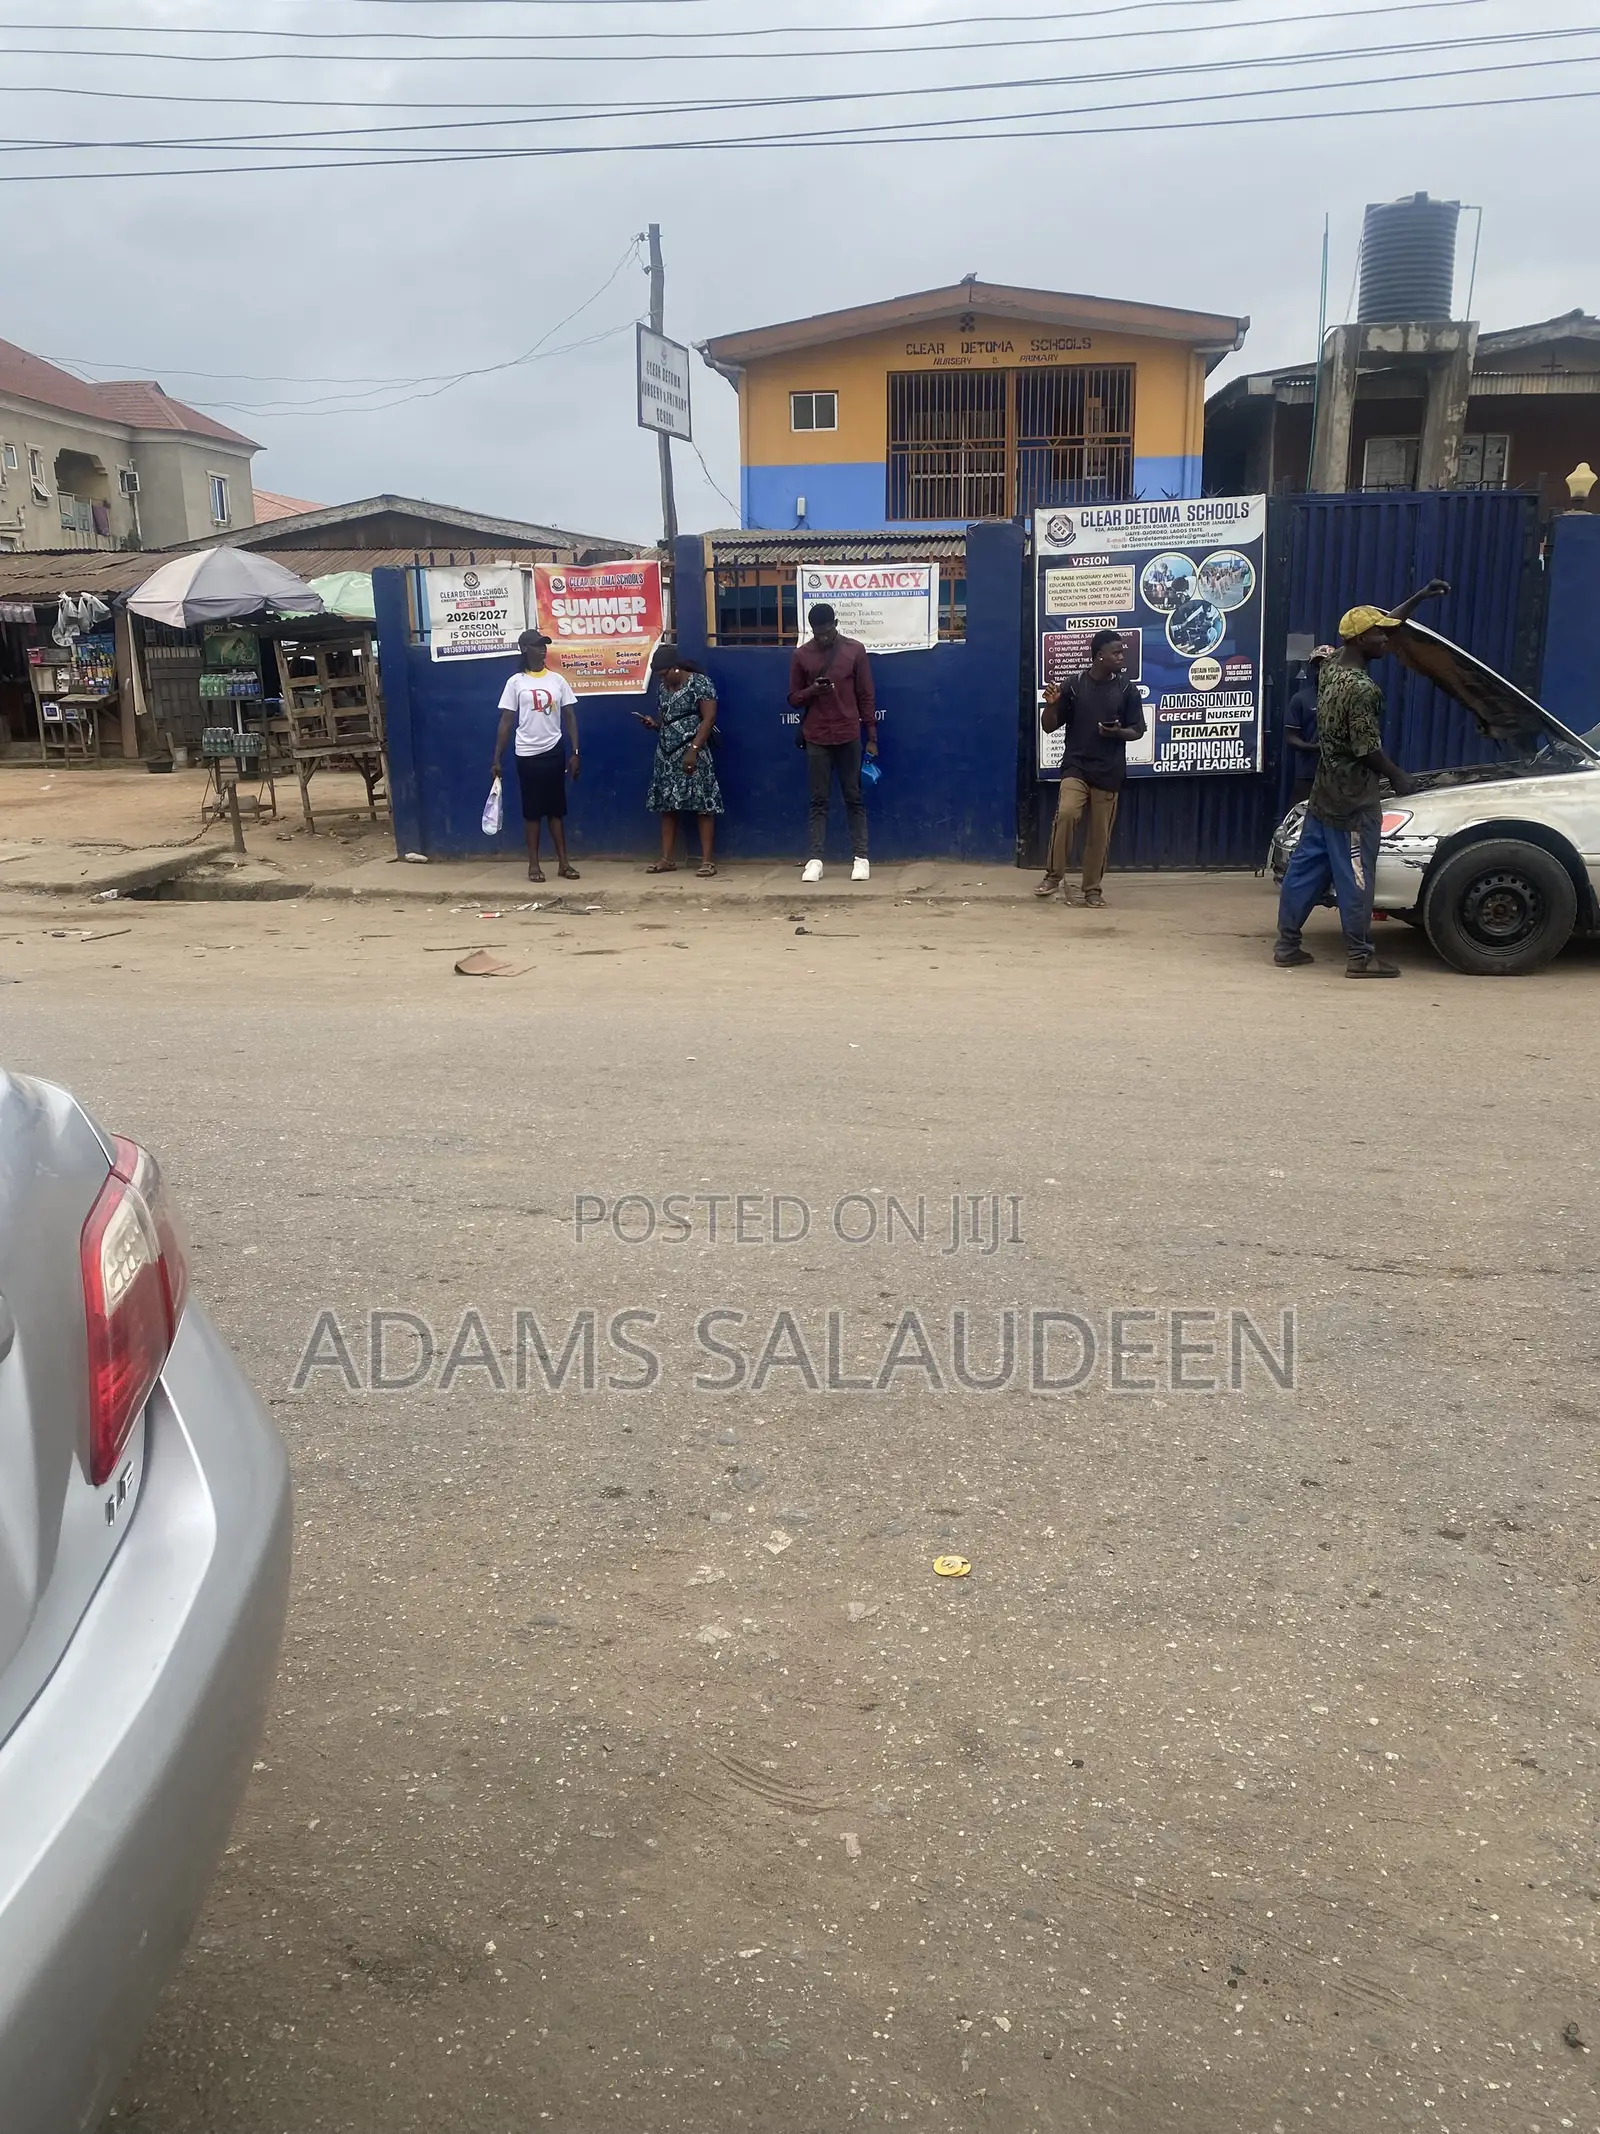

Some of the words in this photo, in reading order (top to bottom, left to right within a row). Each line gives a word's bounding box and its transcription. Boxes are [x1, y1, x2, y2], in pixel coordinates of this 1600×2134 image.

[906, 342, 945, 356] CLEAR
[961, 341, 1014, 354] DETOMA
[1030, 337, 1092, 352] SCHOOLS
[933, 356, 972, 366] NURSERY
[1019, 353, 1059, 363] PRIMARY
[1081, 509, 1122, 527] CLEAR
[1125, 505, 1180, 524] DETOMA
[1187, 502, 1249, 522] SCHOOLS
[1072, 556, 1110, 567] VISION
[569, 576, 589, 587] CLEAR
[589, 575, 615, 586] DETOMA
[616, 573, 644, 585] SCHOOLS
[824, 572, 924, 590] VACANCY
[440, 591, 458, 599] CLEAR
[459, 589, 481, 598] DETOMA
[482, 587, 509, 596] SCHOOLS
[551, 597, 646, 616] SUMMER
[446, 610, 508, 623] 2026/2027
[557, 615, 643, 635] SCHOOL
[1067, 618, 1116, 629] MISSION
[461, 630, 506, 638] ONGOING
[562, 661, 589, 669] Spelling
[608, 667, 630, 675] Crafts
[1161, 693, 1225, 709] ADMISSION
[1226, 692, 1251, 706] INTO
[780, 713, 800, 725] THIS
[1160, 712, 1203, 722] CRECHE
[1207, 710, 1252, 719] NURSERY
[1172, 725, 1239, 739] PRIMARY
[1161, 740, 1244, 761] UPBRINGING
[1153, 760, 1194, 773] GREAT
[1197, 757, 1252, 771] LEADERS
